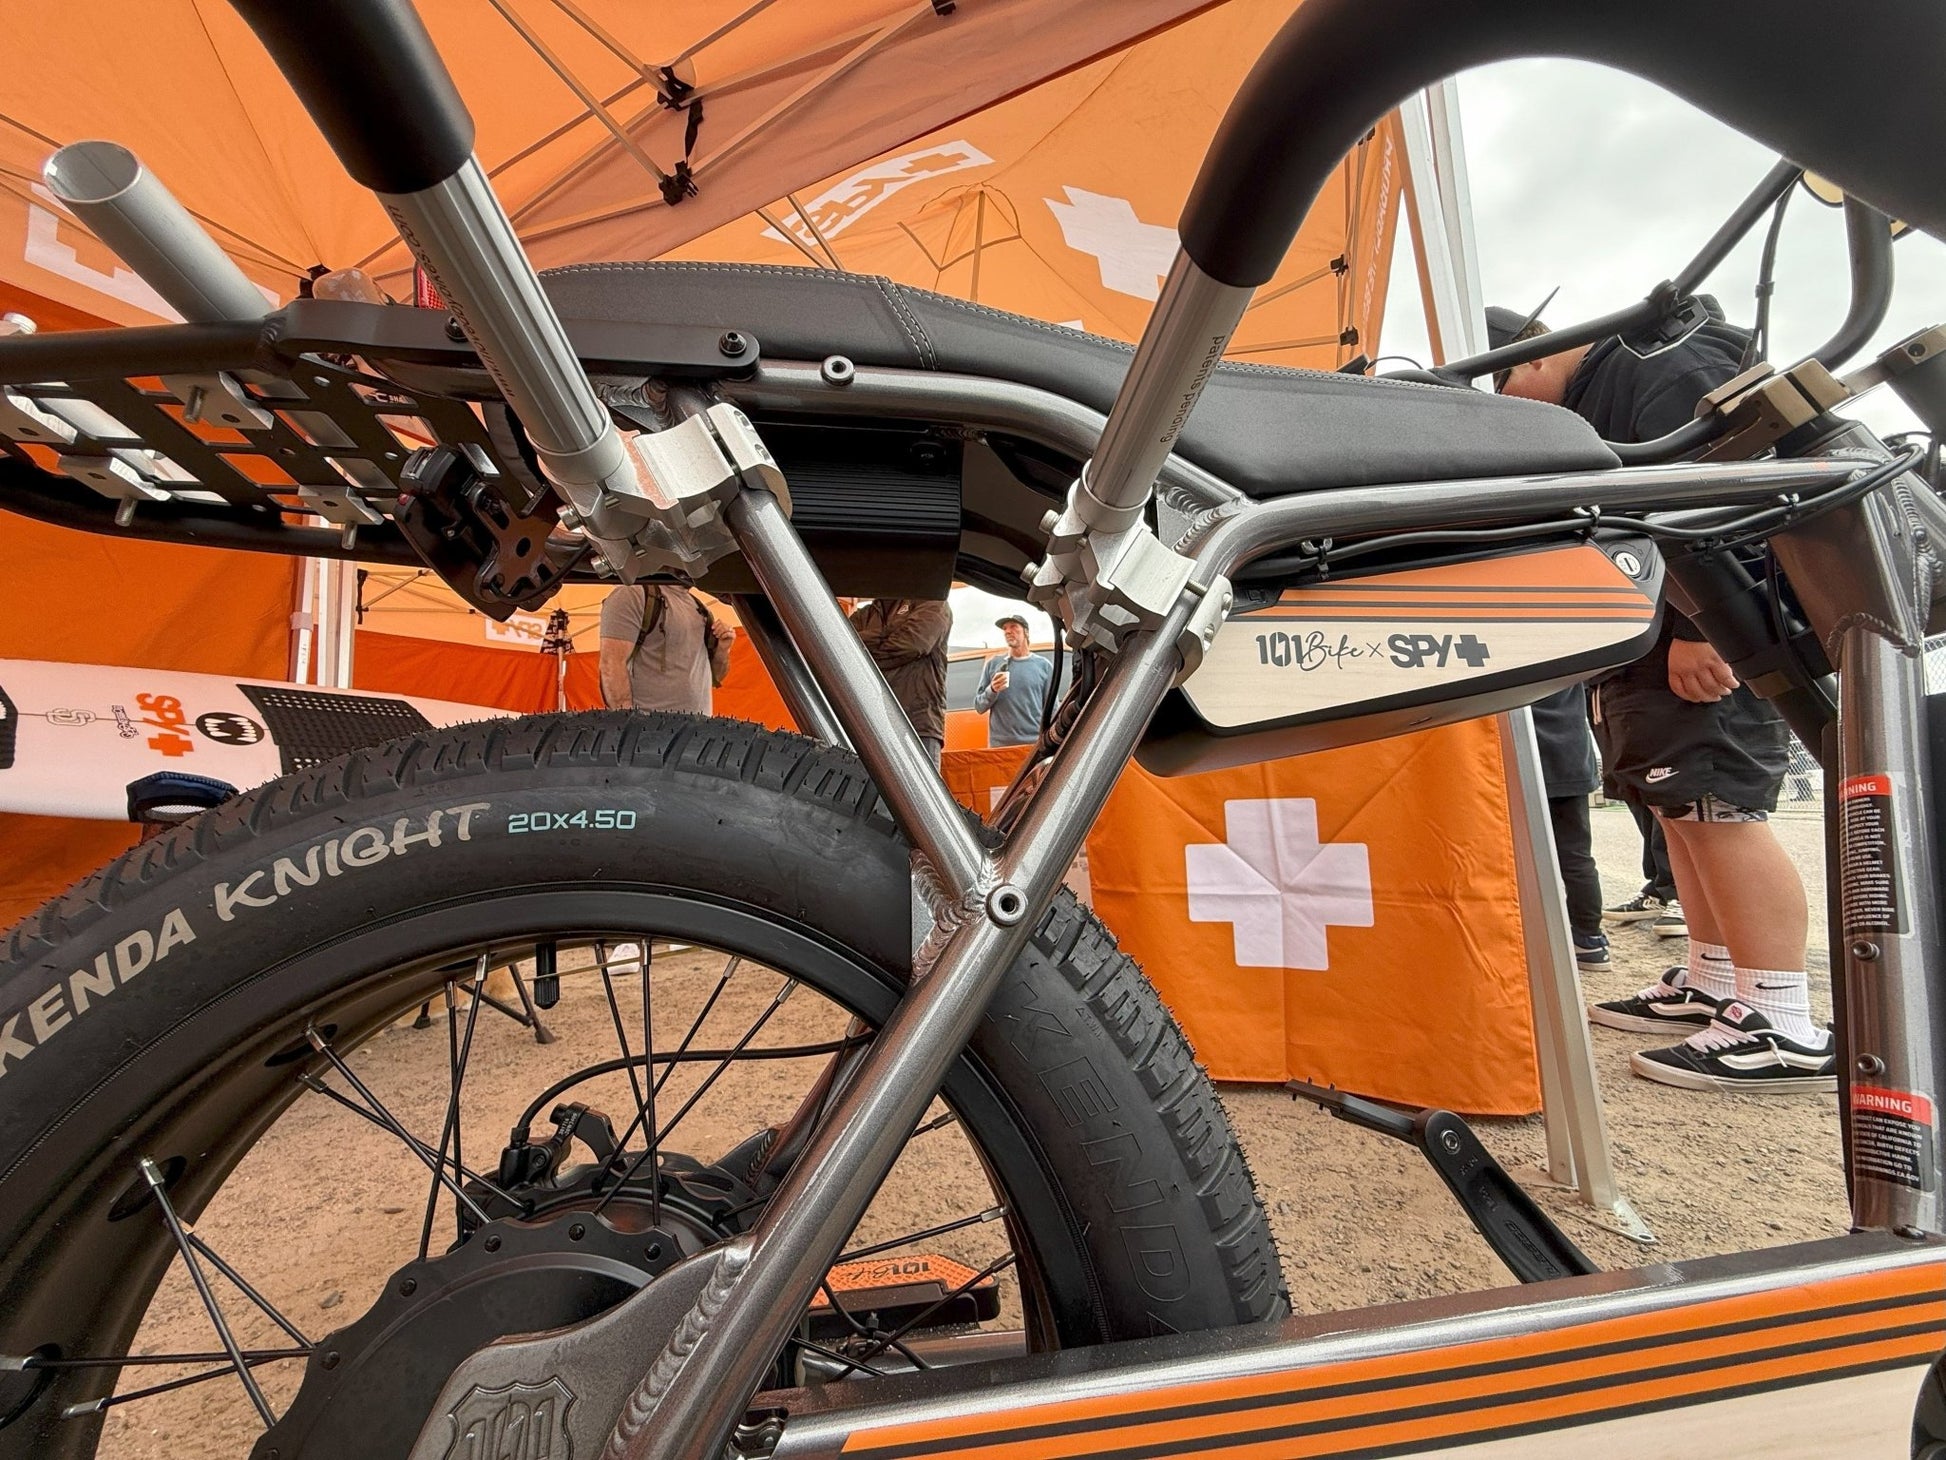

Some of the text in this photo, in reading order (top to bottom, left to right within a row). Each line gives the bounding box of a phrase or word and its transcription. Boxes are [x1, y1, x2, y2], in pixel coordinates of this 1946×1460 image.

[1160, 335, 1225, 443] patents pending
[1649, 767, 1672, 777] NIKE
[214, 802, 491, 922] KNIGHT
[508, 810, 637, 834] 20x4.50
[1884, 1118, 1907, 1127] EXPOSE
[1908, 1123, 1921, 1131] YOU
